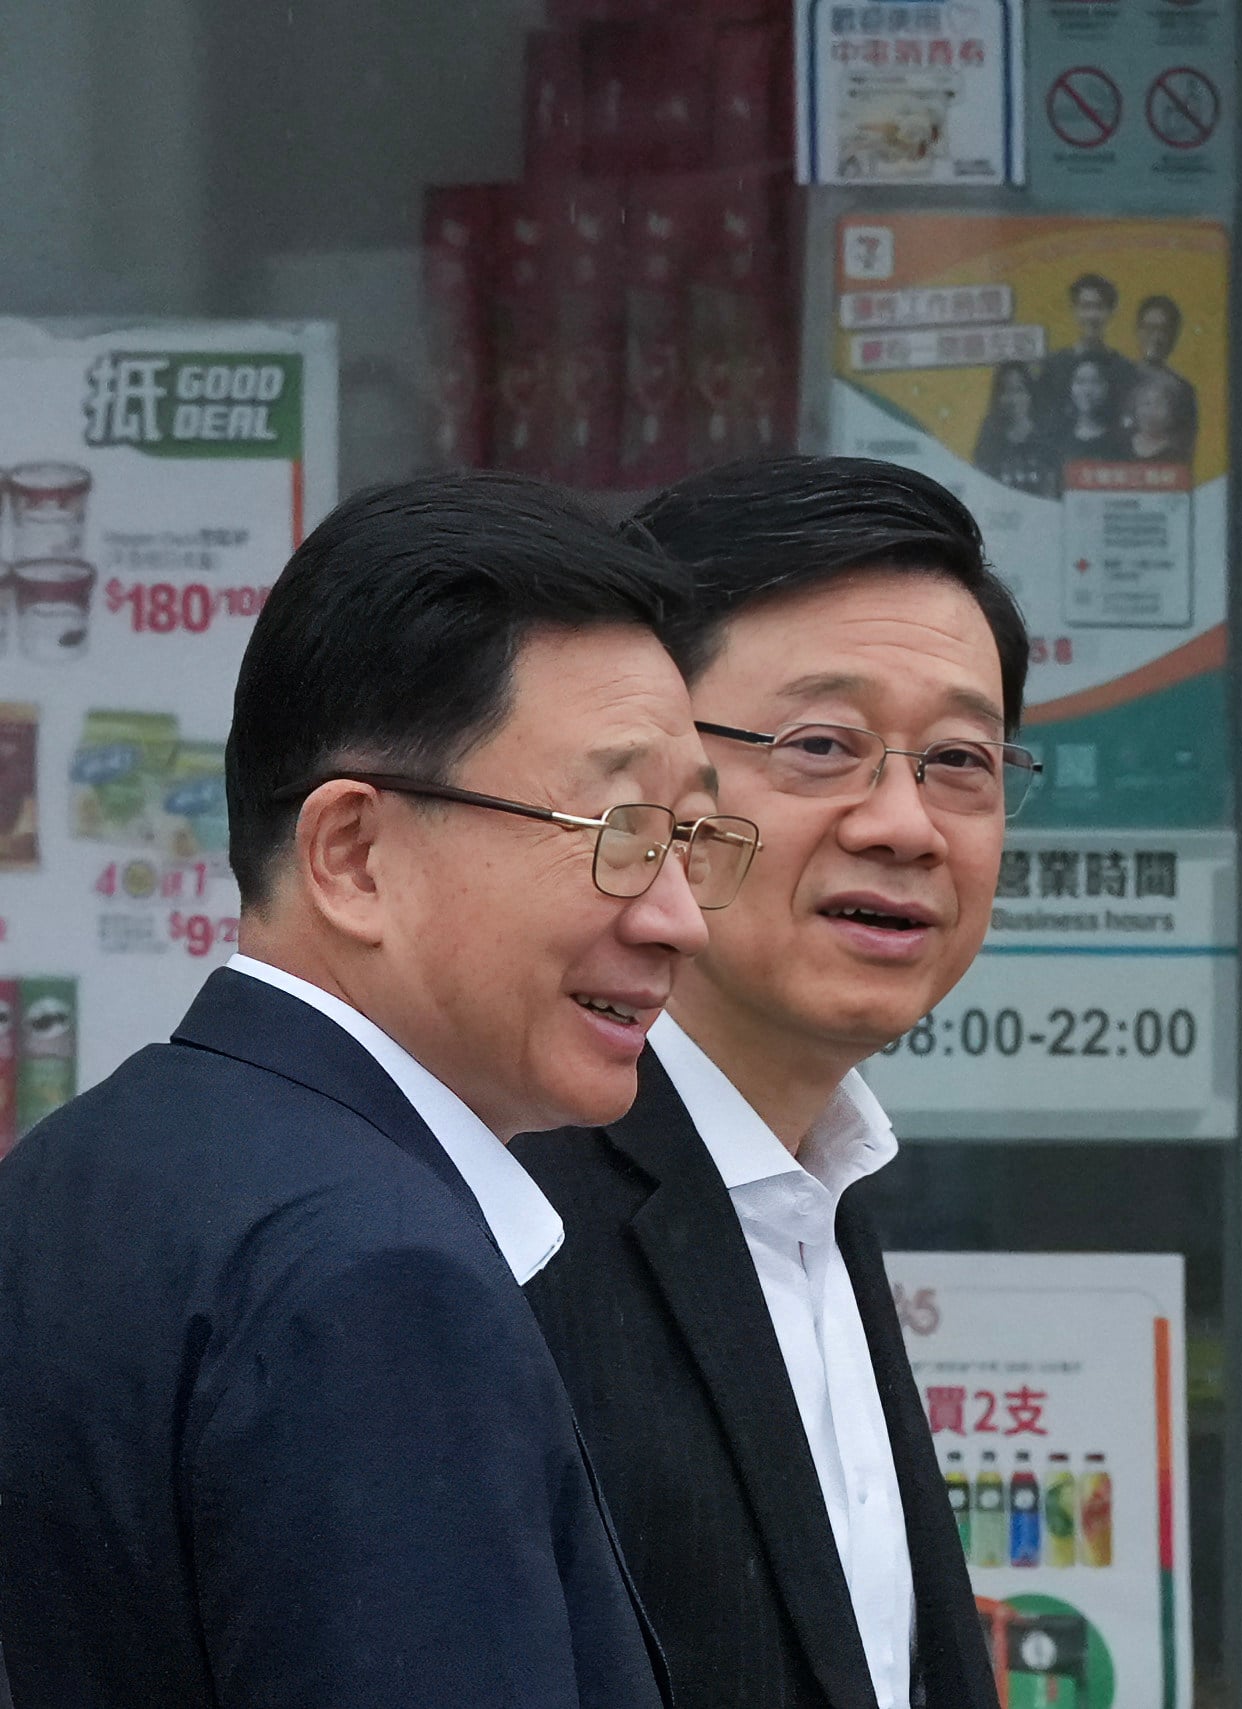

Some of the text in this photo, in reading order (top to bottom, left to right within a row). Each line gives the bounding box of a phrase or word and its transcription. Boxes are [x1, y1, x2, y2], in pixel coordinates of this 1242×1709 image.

[176, 365, 285, 401] GOOD
[172, 403, 279, 441] DEAL
[996, 849, 1178, 899] 營業時間
[1105, 908, 1176, 932] hours
[925, 1383, 1049, 1437] 買2支
